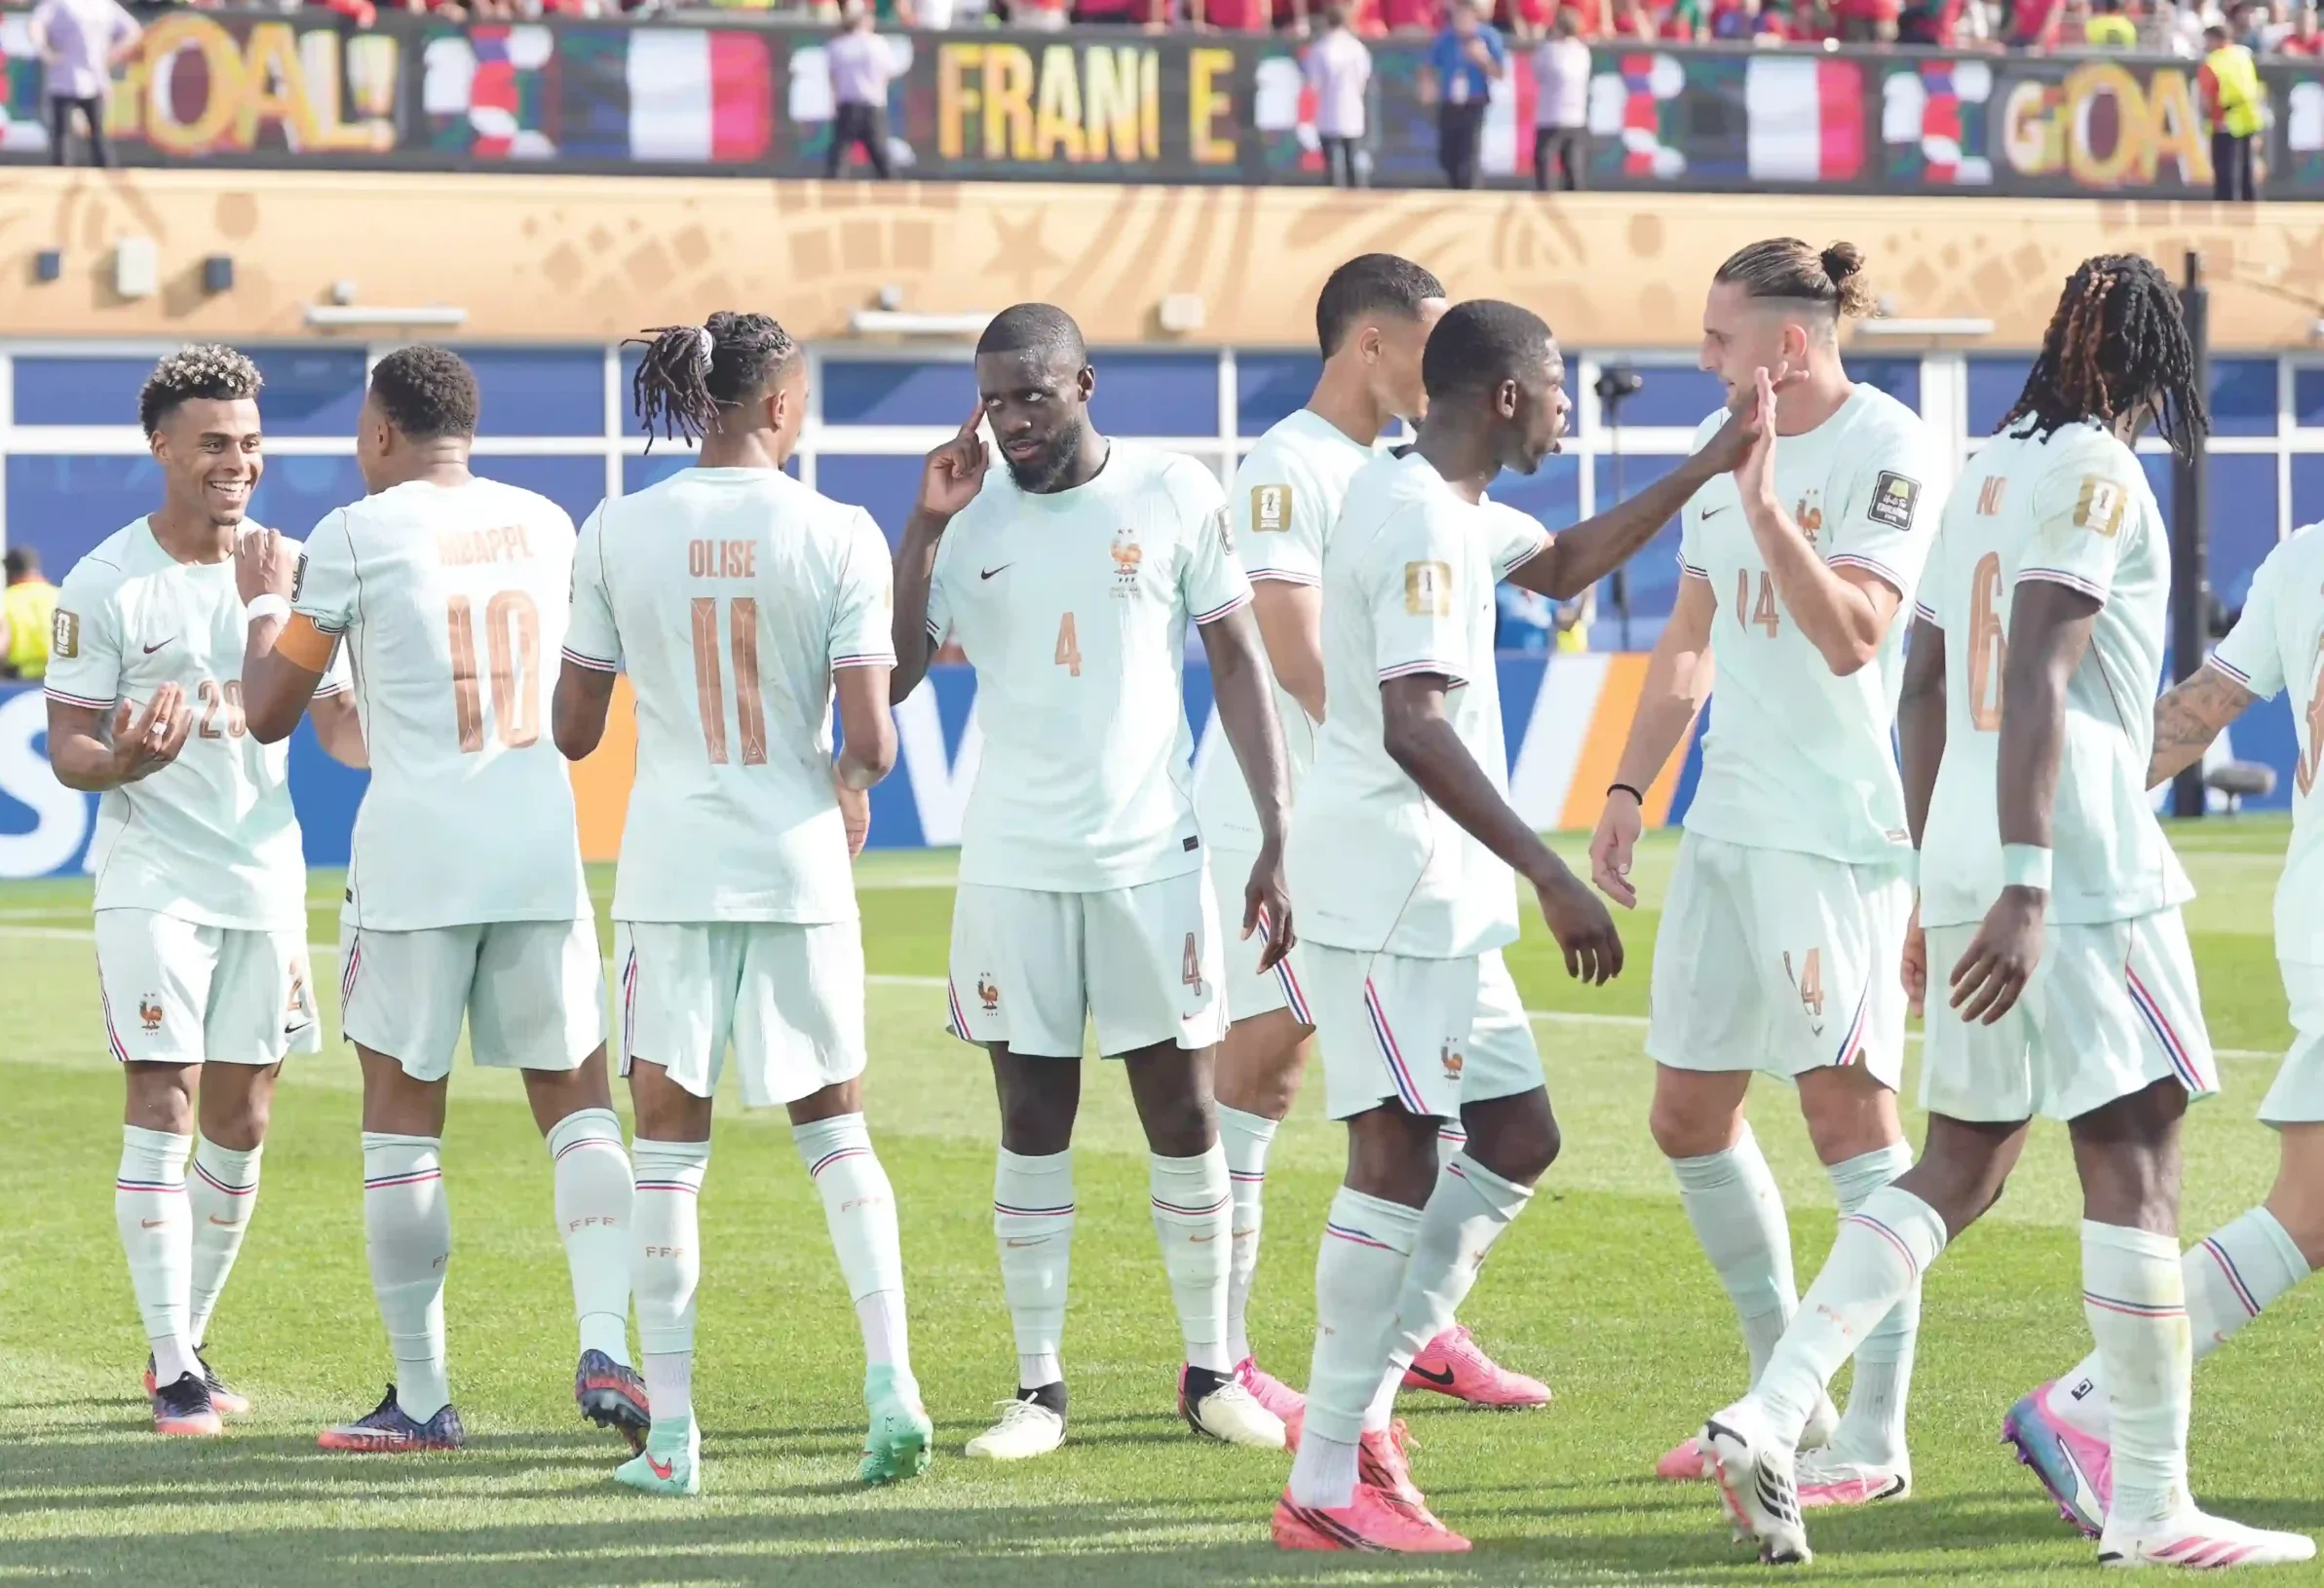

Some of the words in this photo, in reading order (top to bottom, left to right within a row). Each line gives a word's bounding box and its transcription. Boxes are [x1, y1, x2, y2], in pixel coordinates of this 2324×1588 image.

[689, 539, 758, 579] OLISE
[1736, 568, 1780, 638] 14
[446, 589, 541, 753] 10
[1054, 612, 1082, 677] 4
[690, 597, 768, 765] 11
[1182, 931, 1202, 996] 4
[568, 1217, 615, 1231] FFF
[645, 1246, 684, 1258] FFF
